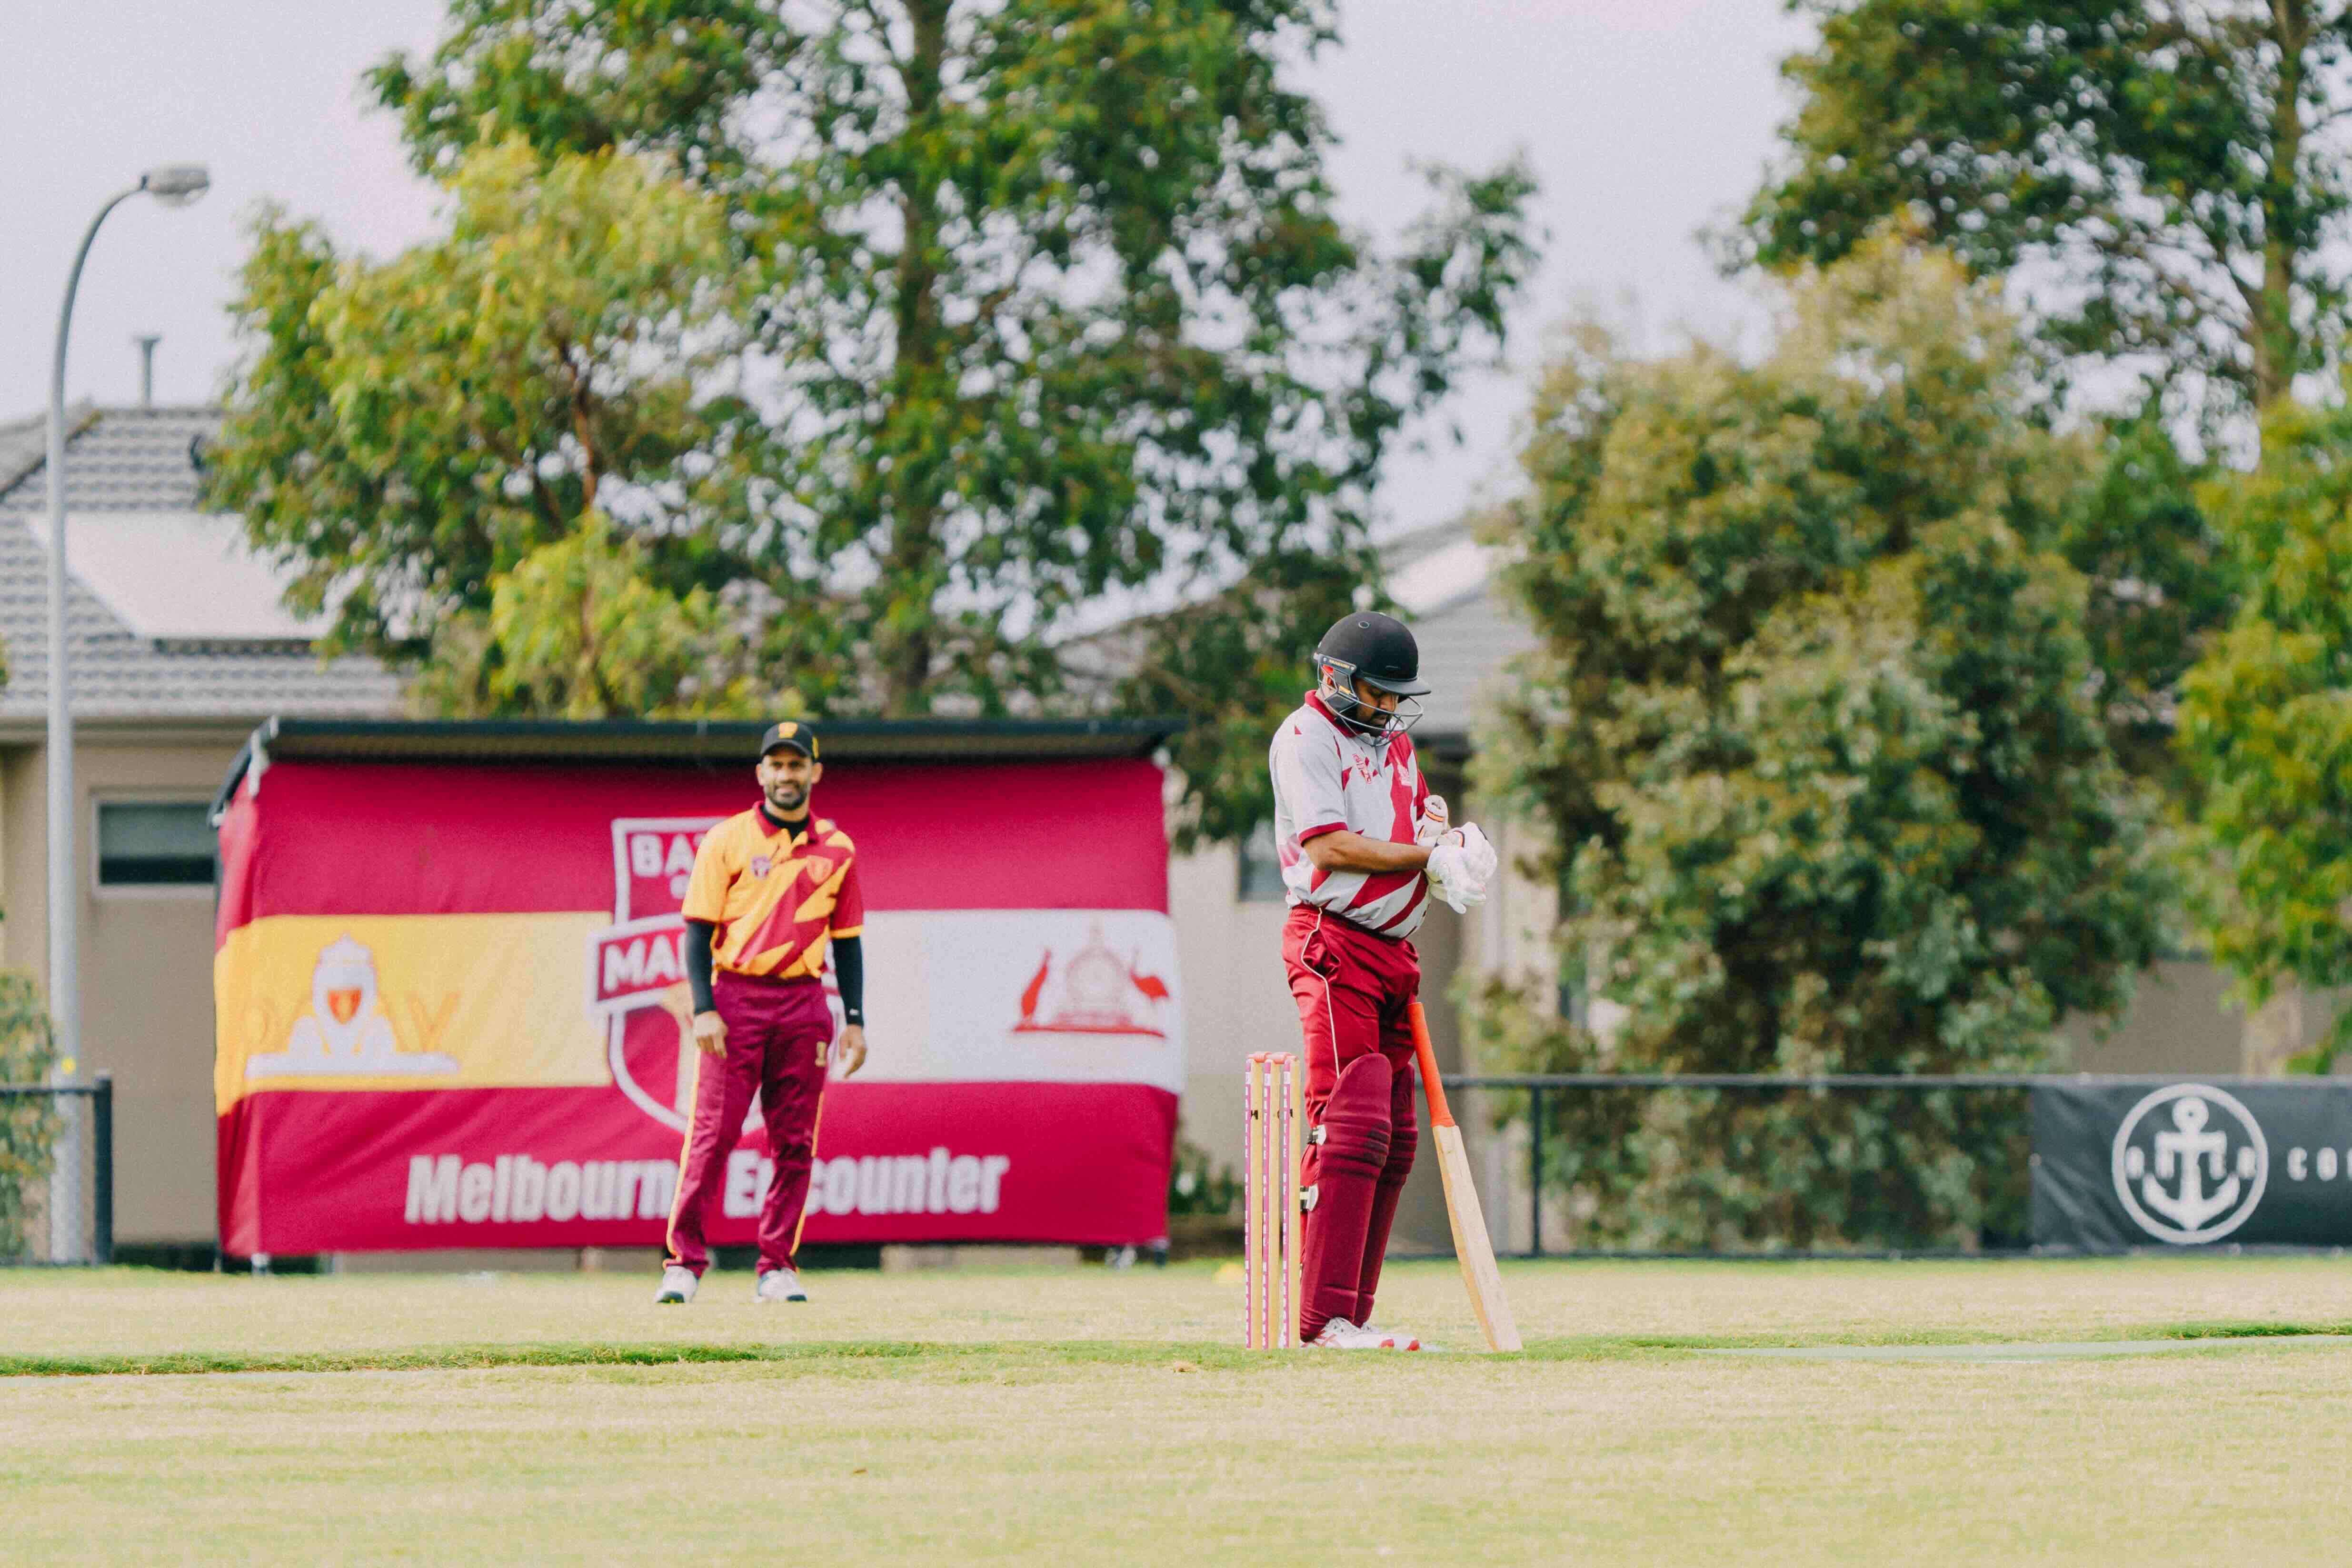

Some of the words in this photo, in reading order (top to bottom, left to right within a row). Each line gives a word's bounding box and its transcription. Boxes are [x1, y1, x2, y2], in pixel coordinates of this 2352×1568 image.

[631, 834, 705, 877] BA
[2287, 1147, 2352, 1181] CO
[405, 1154, 680, 1224] Melbourn
